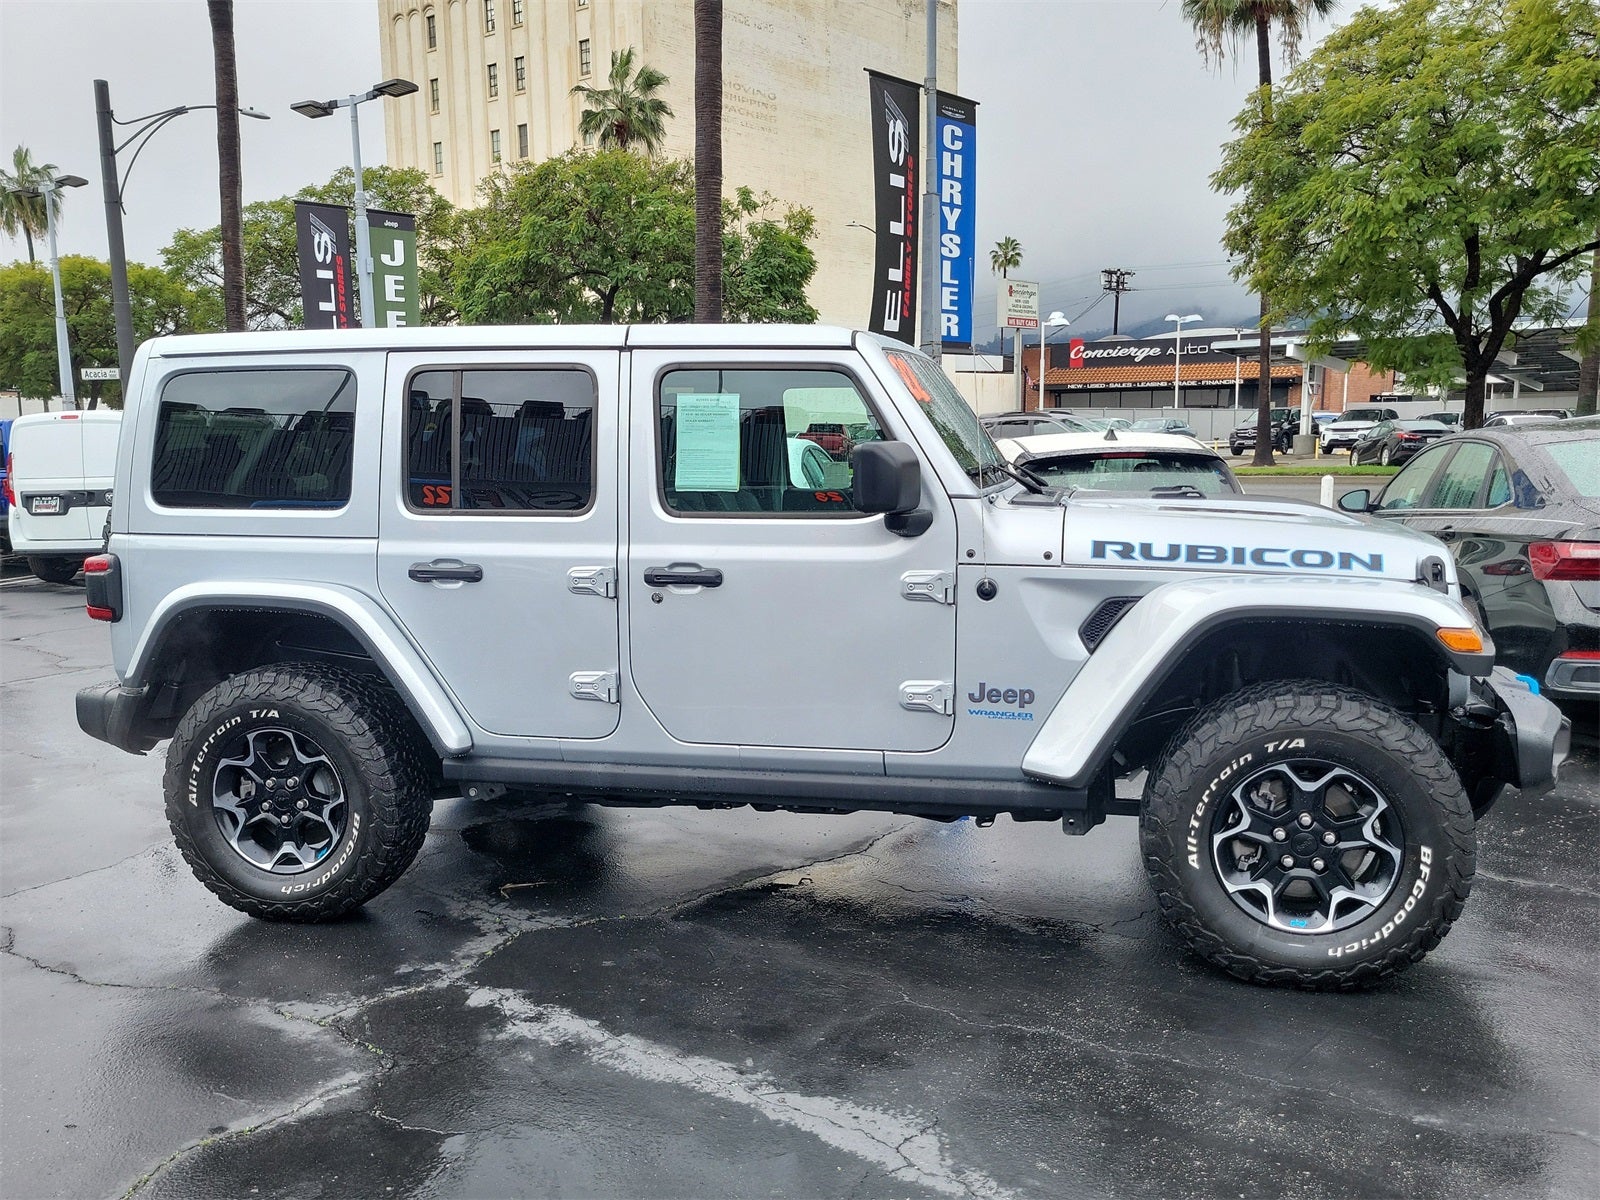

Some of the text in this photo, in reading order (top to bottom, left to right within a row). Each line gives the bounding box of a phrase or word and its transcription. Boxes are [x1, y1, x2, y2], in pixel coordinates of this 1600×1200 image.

[883, 119, 905, 332] ELLIS
[903, 154, 914, 318] FAMILY STORES
[940, 124, 963, 337] CHRYSLER
[336, 255, 346, 313] STORES
[84, 370, 107, 378] Acacia
[1070, 345, 1161, 363] Concierge
[1091, 539, 1384, 572] RUBICON
[968, 682, 1035, 708] Jeep
[968, 709, 1033, 718] WRANGLER
[189, 709, 279, 807] All-Terrain T/A
[1187, 738, 1305, 869] All-Terrain T/A
[281, 812, 360, 894] BFGoodrich
[1328, 845, 1432, 957] BFGoodrich
